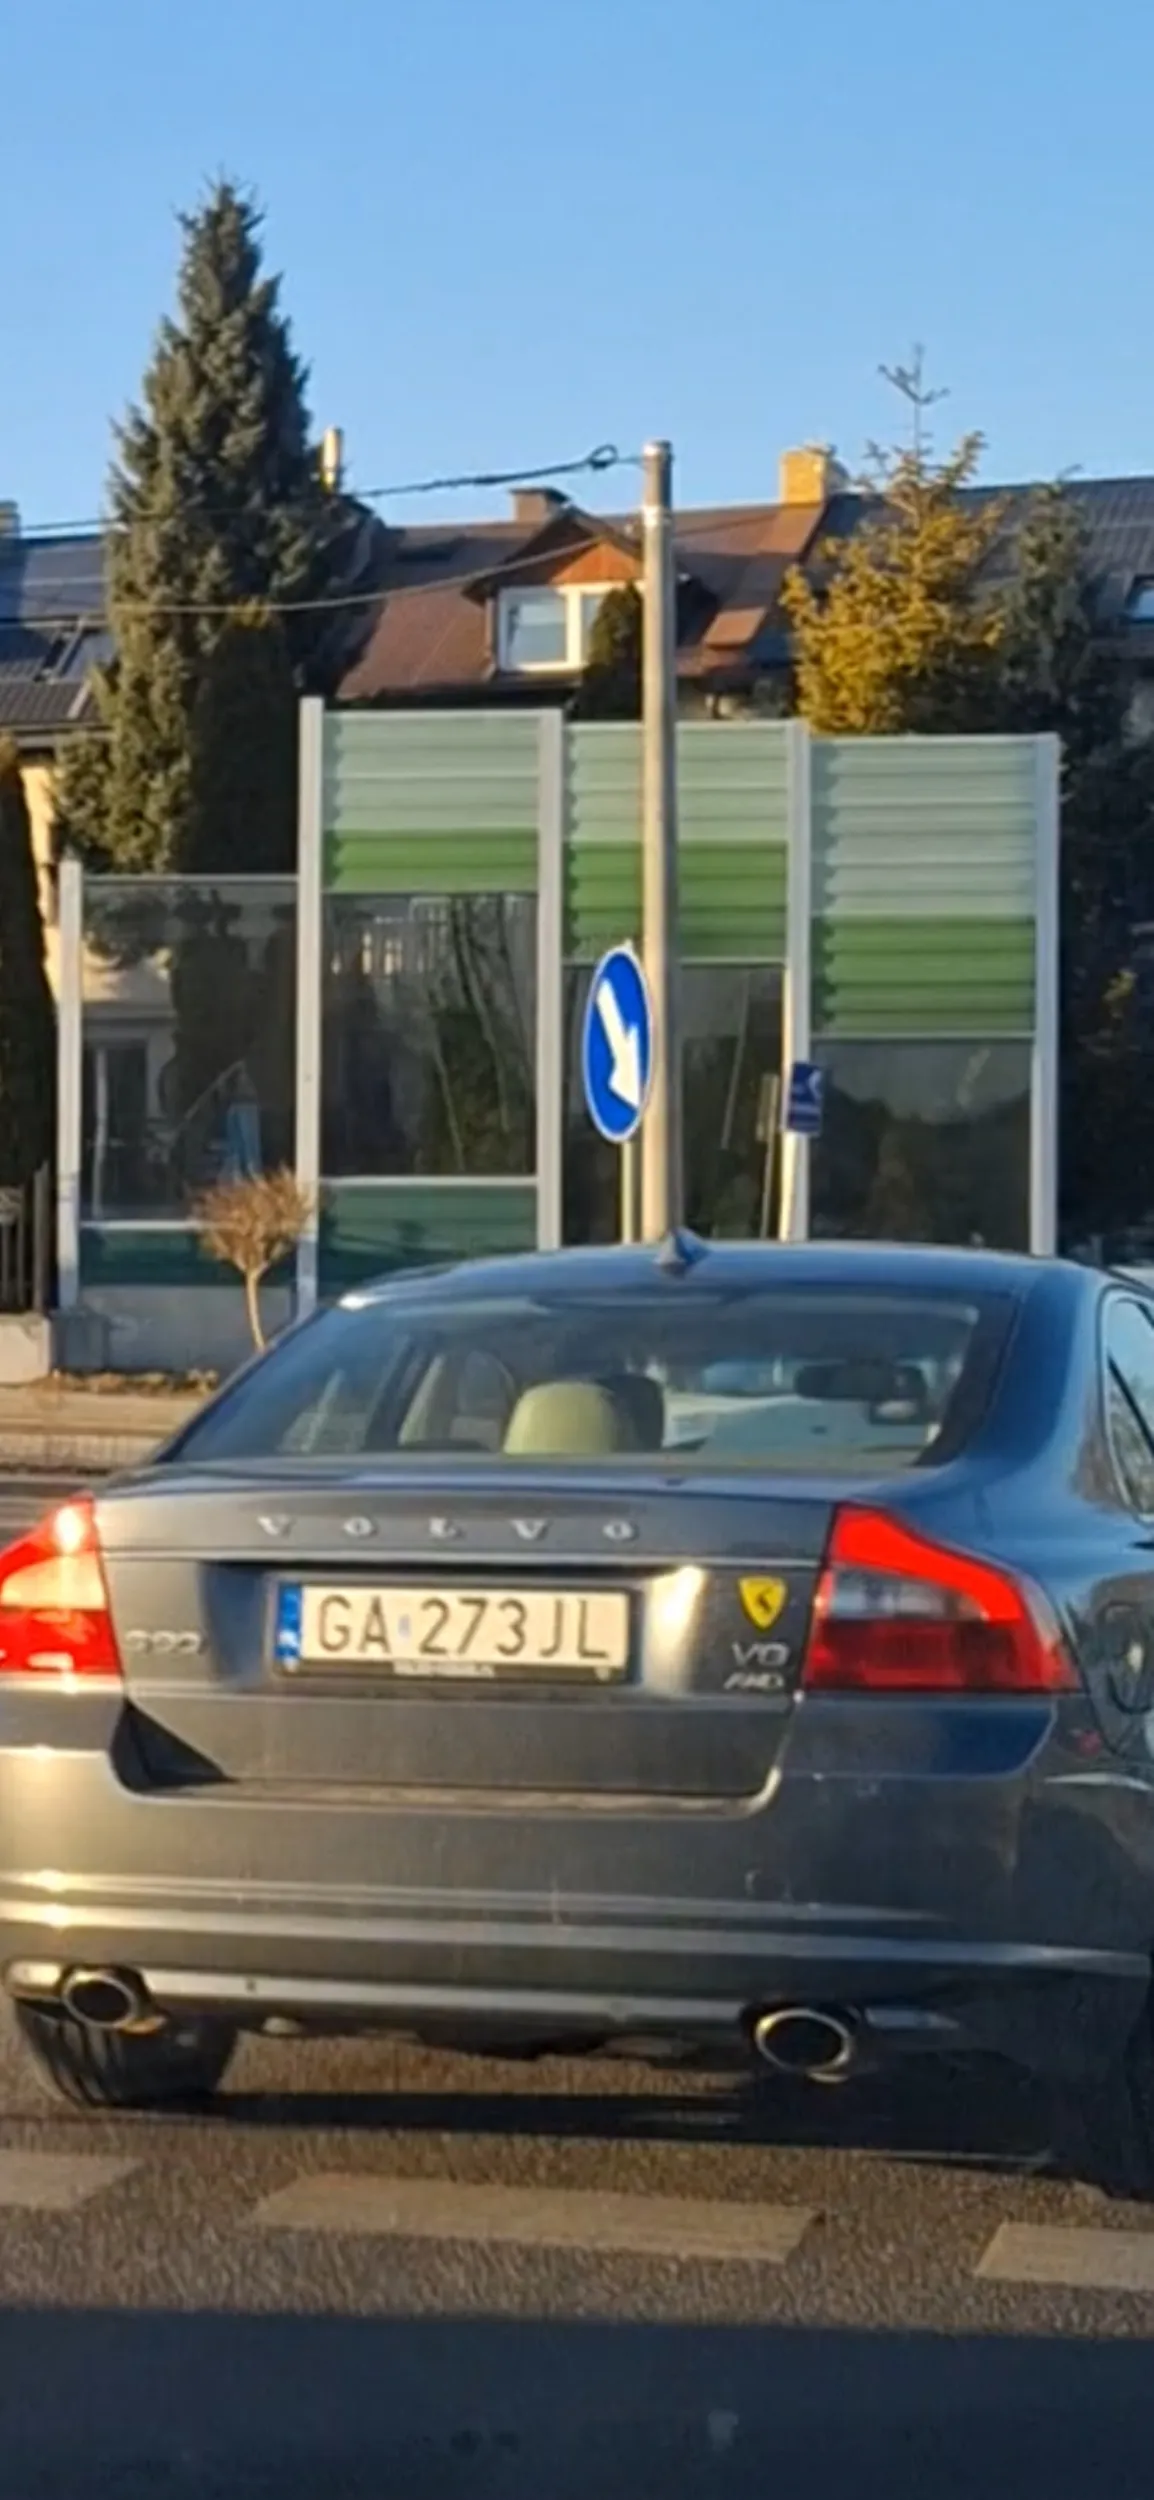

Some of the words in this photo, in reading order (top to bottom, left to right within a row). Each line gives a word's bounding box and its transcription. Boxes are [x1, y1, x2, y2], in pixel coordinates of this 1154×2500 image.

[256, 1515, 638, 1542] VOLVO
[317, 1593, 392, 1654] GA
[418, 1596, 611, 1659] 273JL
